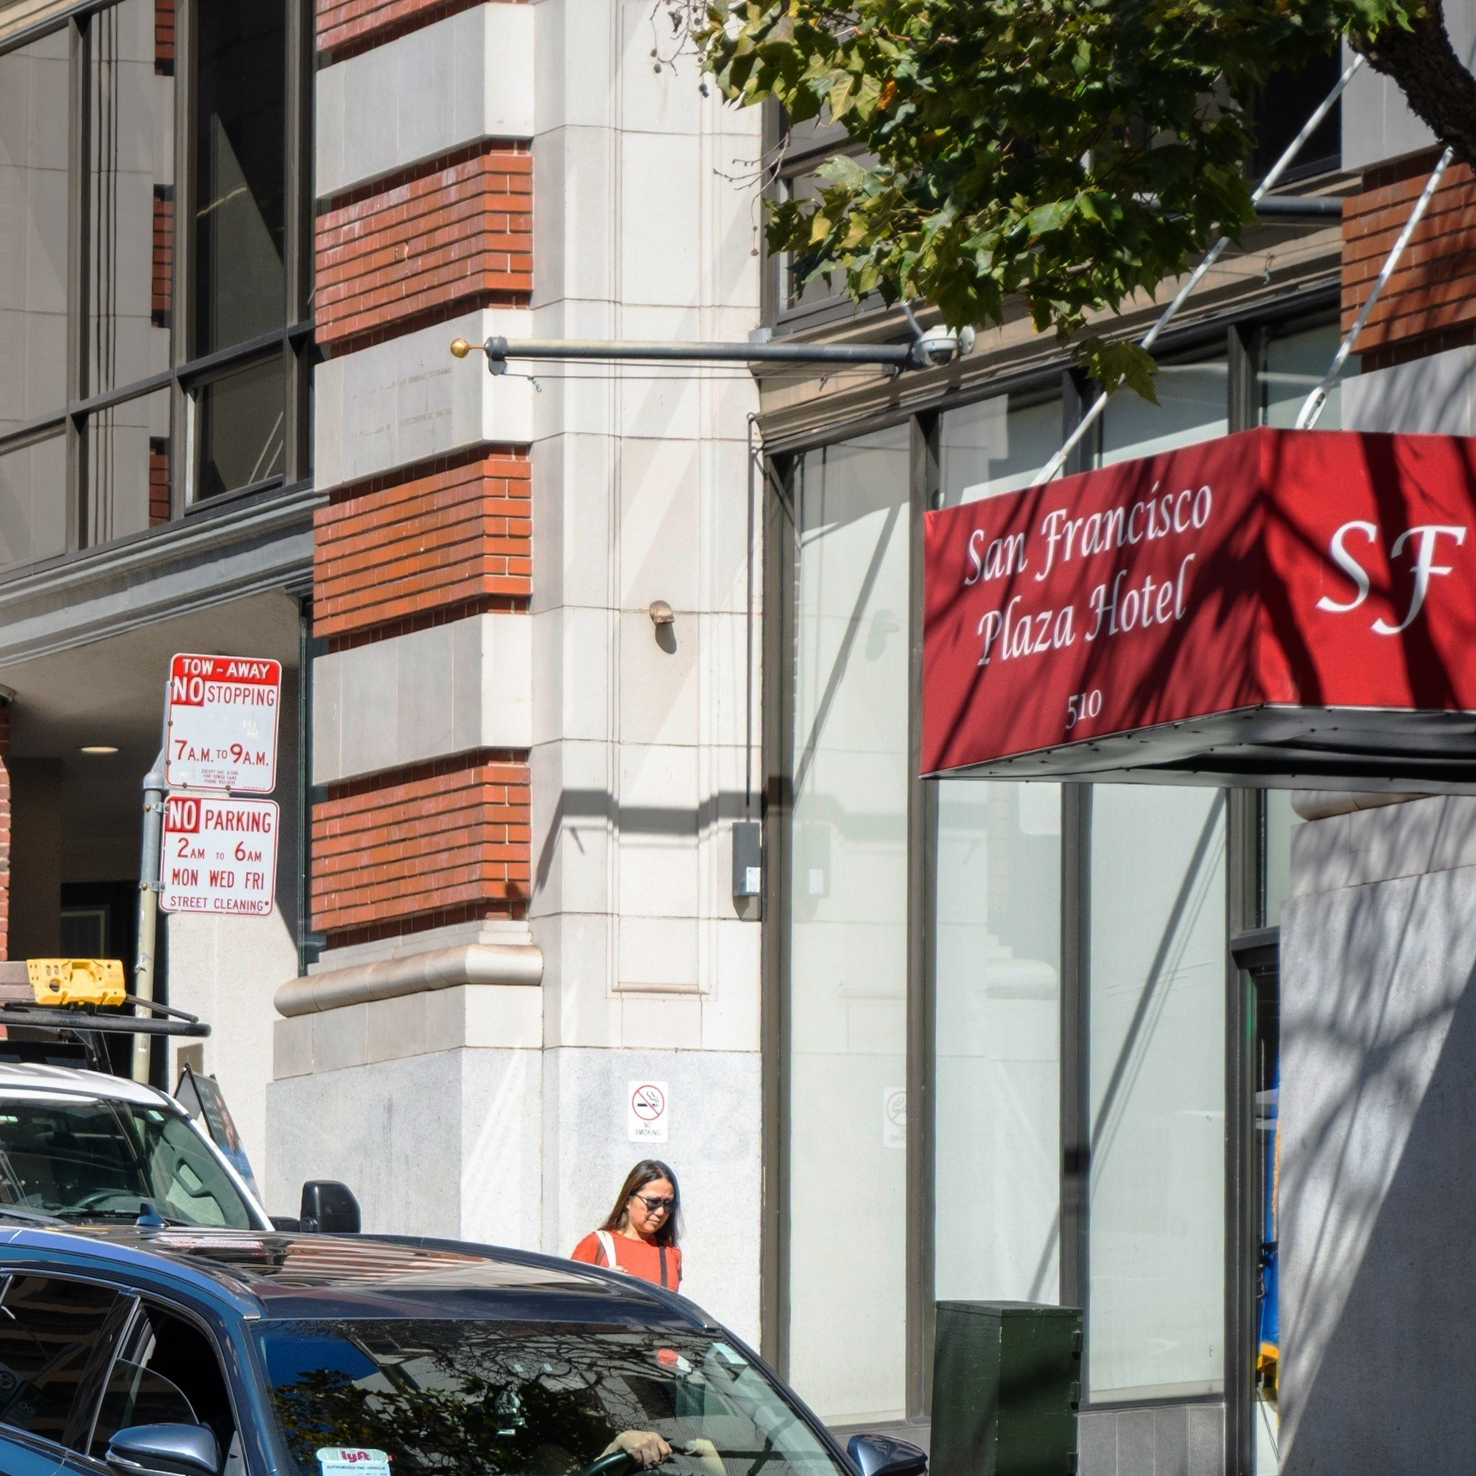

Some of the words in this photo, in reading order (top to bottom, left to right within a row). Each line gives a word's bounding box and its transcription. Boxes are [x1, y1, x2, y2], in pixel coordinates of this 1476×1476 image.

[965, 527, 1028, 587] San
[1035, 480, 1213, 582] Francisco
[976, 595, 1075, 667] Plaza
[1085, 552, 1196, 643] Hotel
[172, 675, 204, 703] NO
[207, 685, 275, 707] STOPPING
[1065, 689, 1103, 730] 510
[216, 749, 228, 760] TO
[169, 799, 197, 830] NO
[204, 809, 272, 834] PARKING
[215, 852, 225, 860] TO
[171, 868, 199, 887] MON
[209, 869, 235, 889] WED
[244, 871, 265, 890] FRI
[170, 895, 208, 909] STREET
[213, 897, 264, 912] CLEANING
[341, 1450, 371, 1463] lyft
